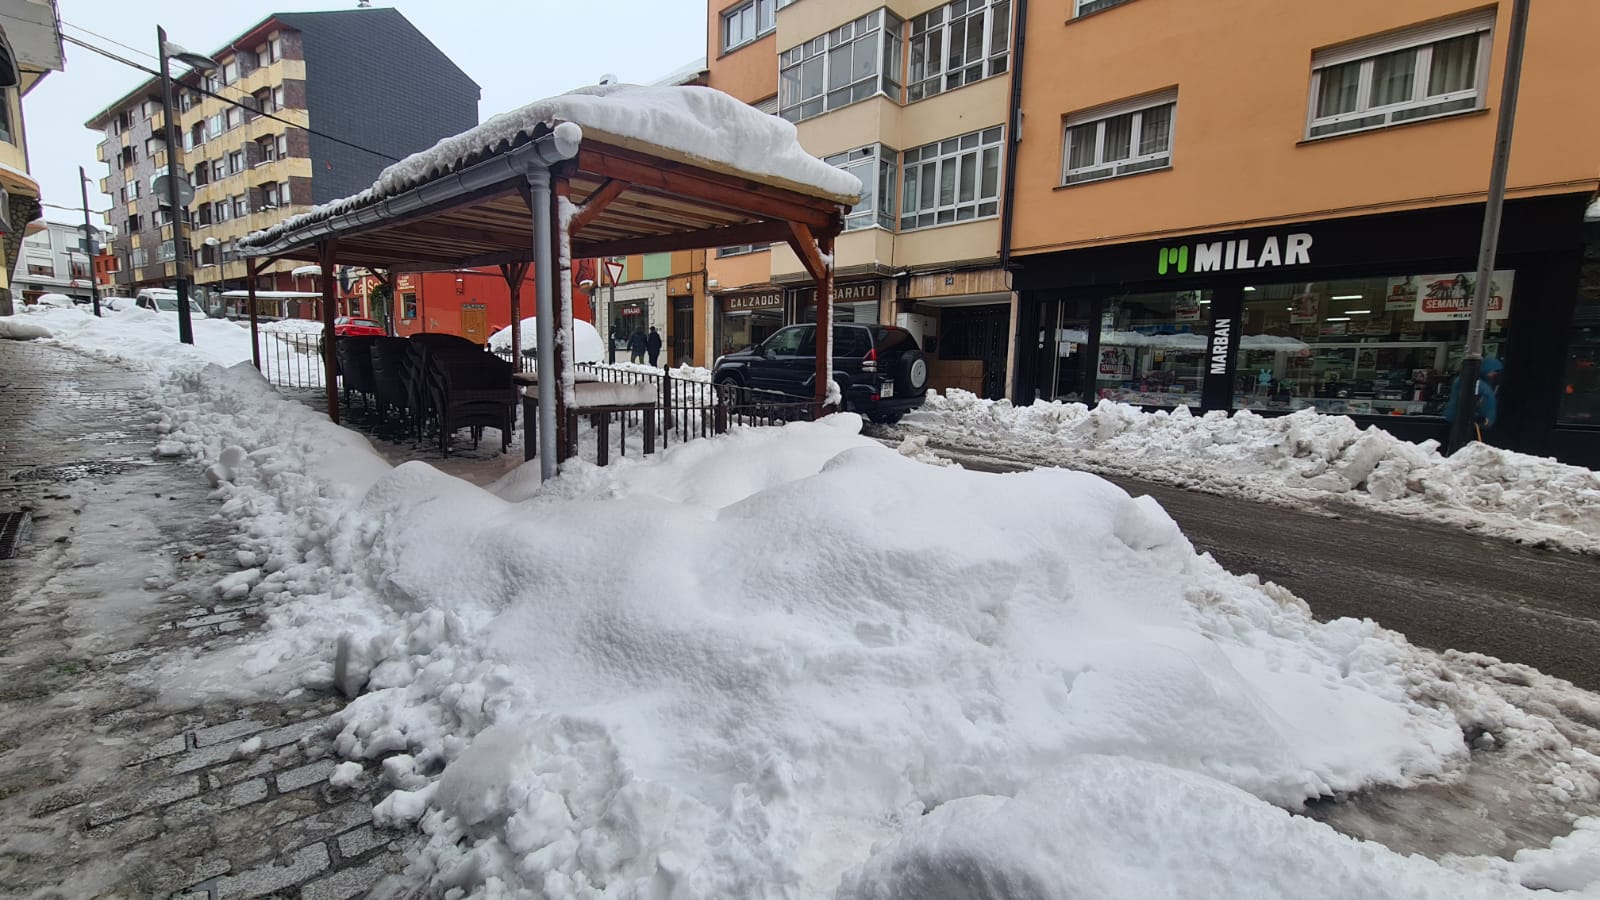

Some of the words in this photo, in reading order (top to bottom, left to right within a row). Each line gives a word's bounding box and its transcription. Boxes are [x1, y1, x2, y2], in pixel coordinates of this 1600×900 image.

[1193, 232, 1313, 272] MILAR
[730, 294, 780, 308] CALZADOS
[1425, 298, 1466, 309] SEMANA
[1210, 318, 1231, 374] MARBAN
